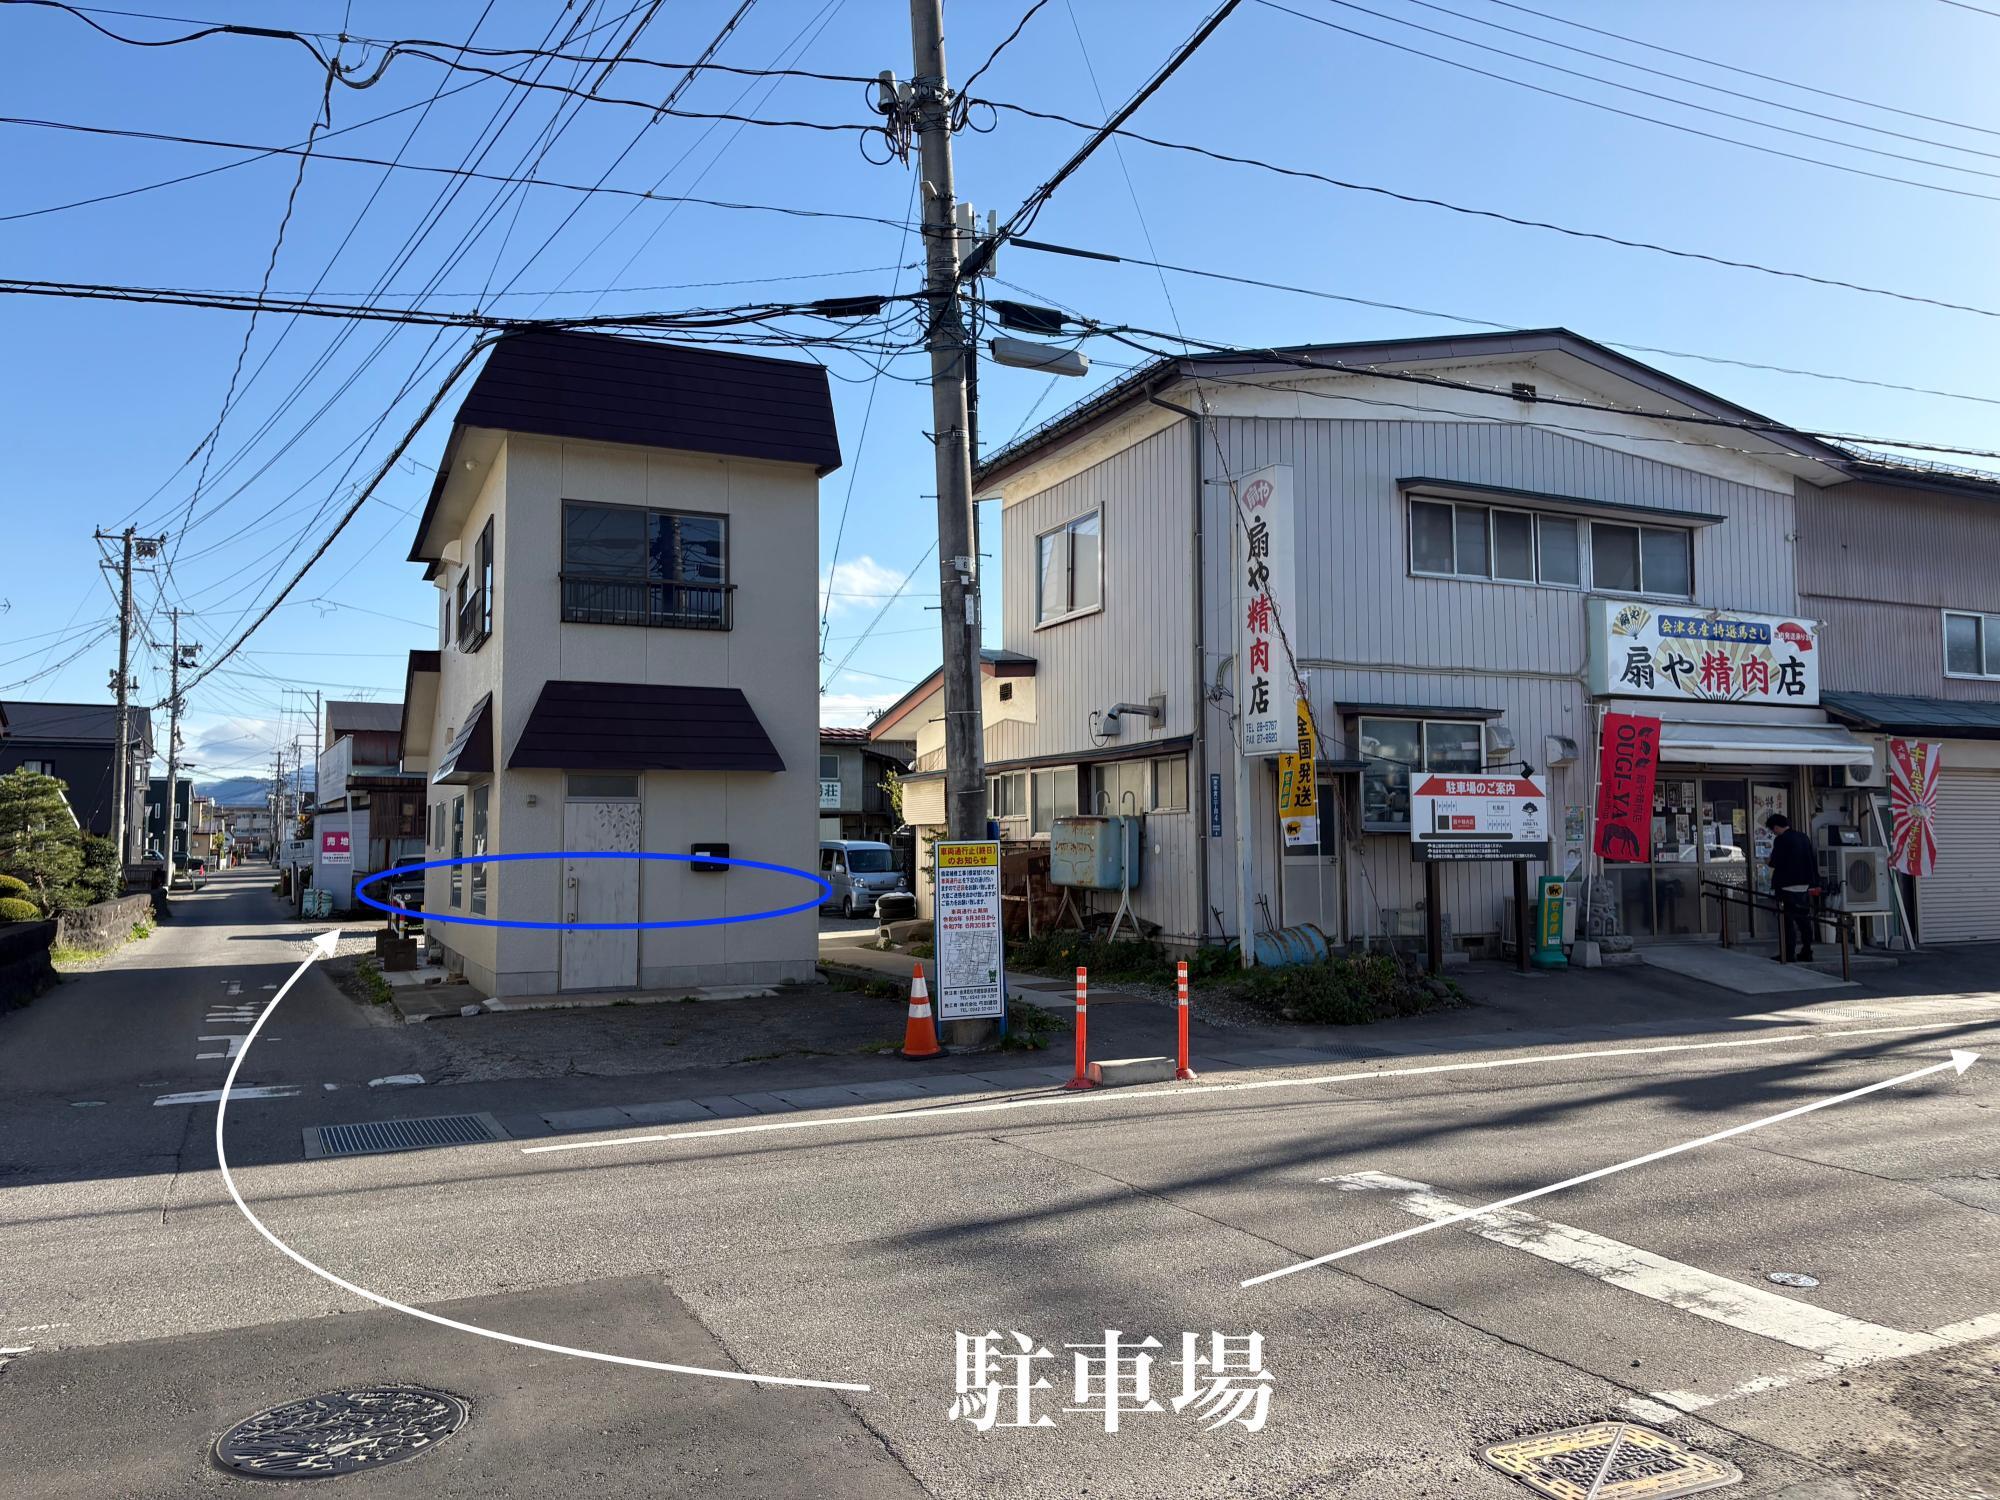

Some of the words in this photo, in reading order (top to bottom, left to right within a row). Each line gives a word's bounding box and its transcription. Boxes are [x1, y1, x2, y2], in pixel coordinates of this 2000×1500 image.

[1247, 481, 1270, 509] 扇や
[1246, 515, 1272, 717] 扇や精肉店
[1619, 646, 1807, 697] 扇や精肉店
[1445, 781, 1516, 796] 駐車場のご案内
[1611, 724, 1636, 820] OUGI-YA
[948, 856, 988, 865] のお知らせ
